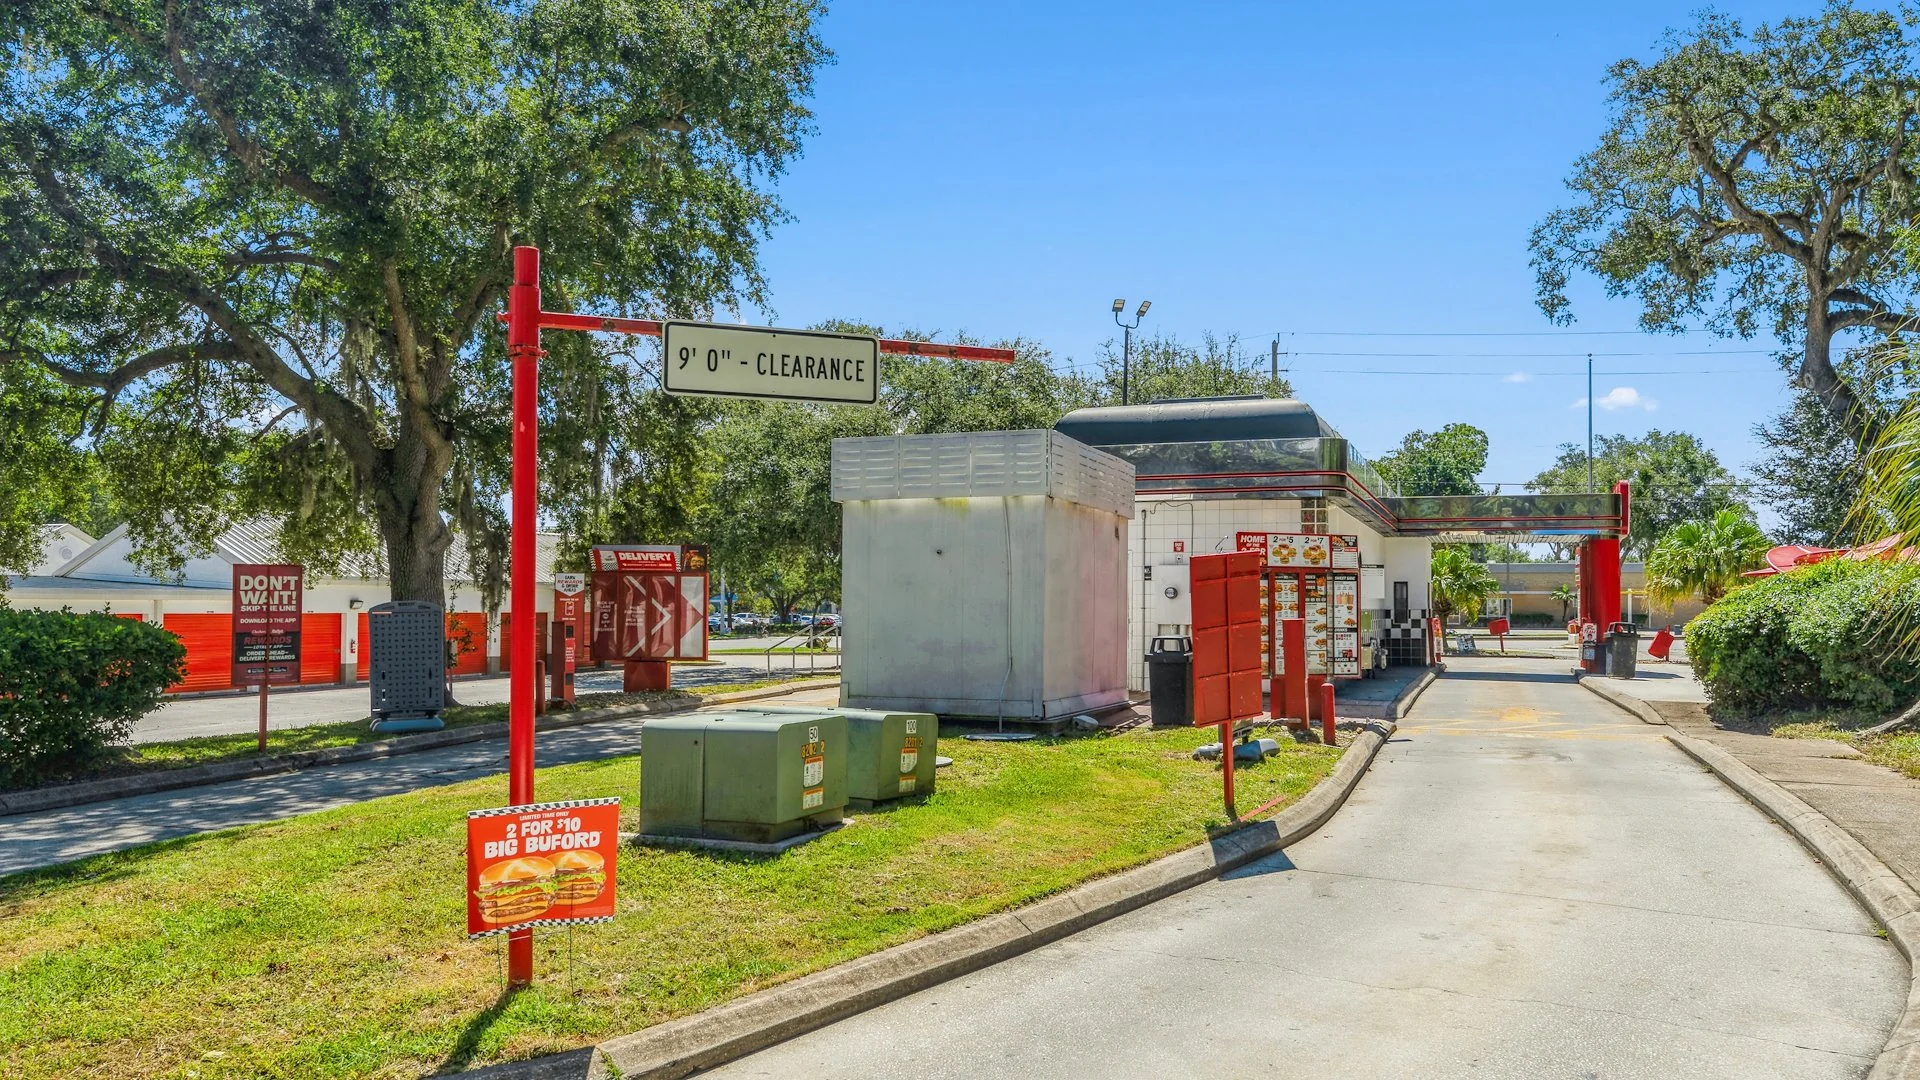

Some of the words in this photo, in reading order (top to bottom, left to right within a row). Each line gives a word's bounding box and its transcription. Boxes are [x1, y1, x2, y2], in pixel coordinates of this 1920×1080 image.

[679, 347, 696, 370] 9'
[757, 352, 865, 383] CLEARANCE
[1240, 535, 1265, 543] HOME
[618, 552, 671, 561] DELIVERY
[240, 575, 298, 590] DON'T
[240, 591, 297, 605] WAIT!
[906, 720, 917, 731] 100
[809, 727, 818, 740] 50
[820, 740, 825, 753] 2
[506, 823, 517, 838] 2
[520, 819, 553, 837] FOR
[556, 817, 581, 832] $10
[484, 839, 518, 859] BIG
[525, 831, 600, 853] BUFORD
